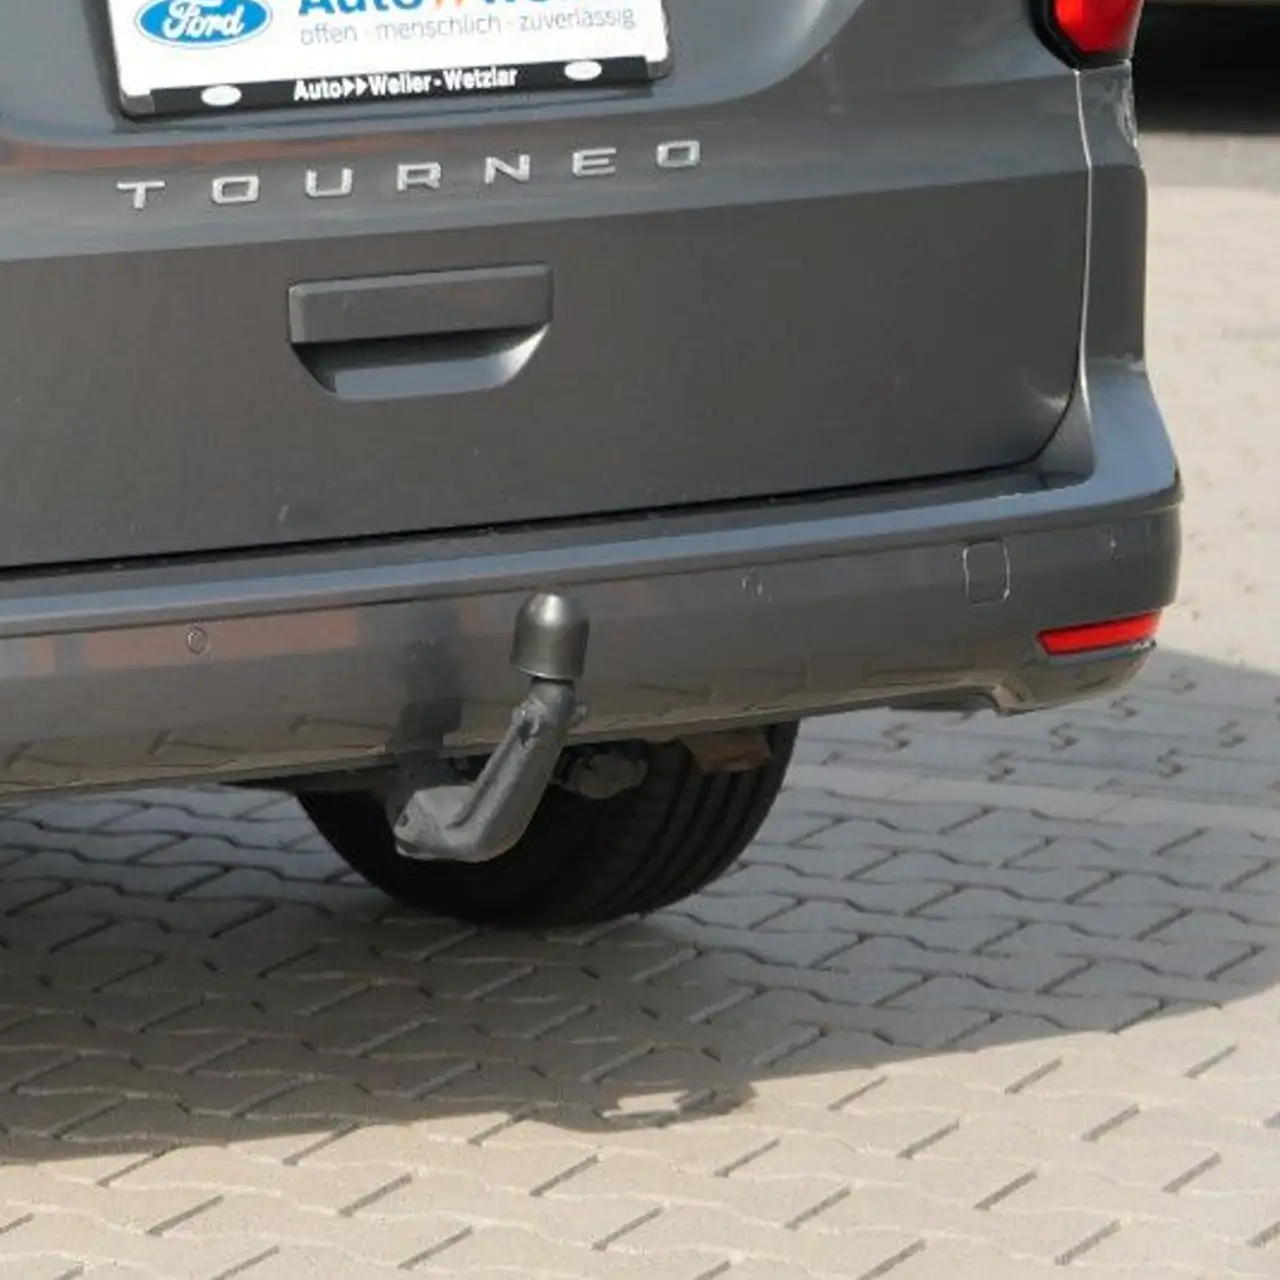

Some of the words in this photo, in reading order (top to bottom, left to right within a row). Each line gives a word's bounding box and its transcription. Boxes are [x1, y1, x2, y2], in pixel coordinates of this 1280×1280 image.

[300, 22, 358, 47] offen
[376, 13, 502, 42] menschlich
[293, 78, 342, 102] Auto
[367, 71, 431, 97] Weller
[442, 67, 519, 92] Wetzlar
[116, 140, 701, 210] TOURNEO
